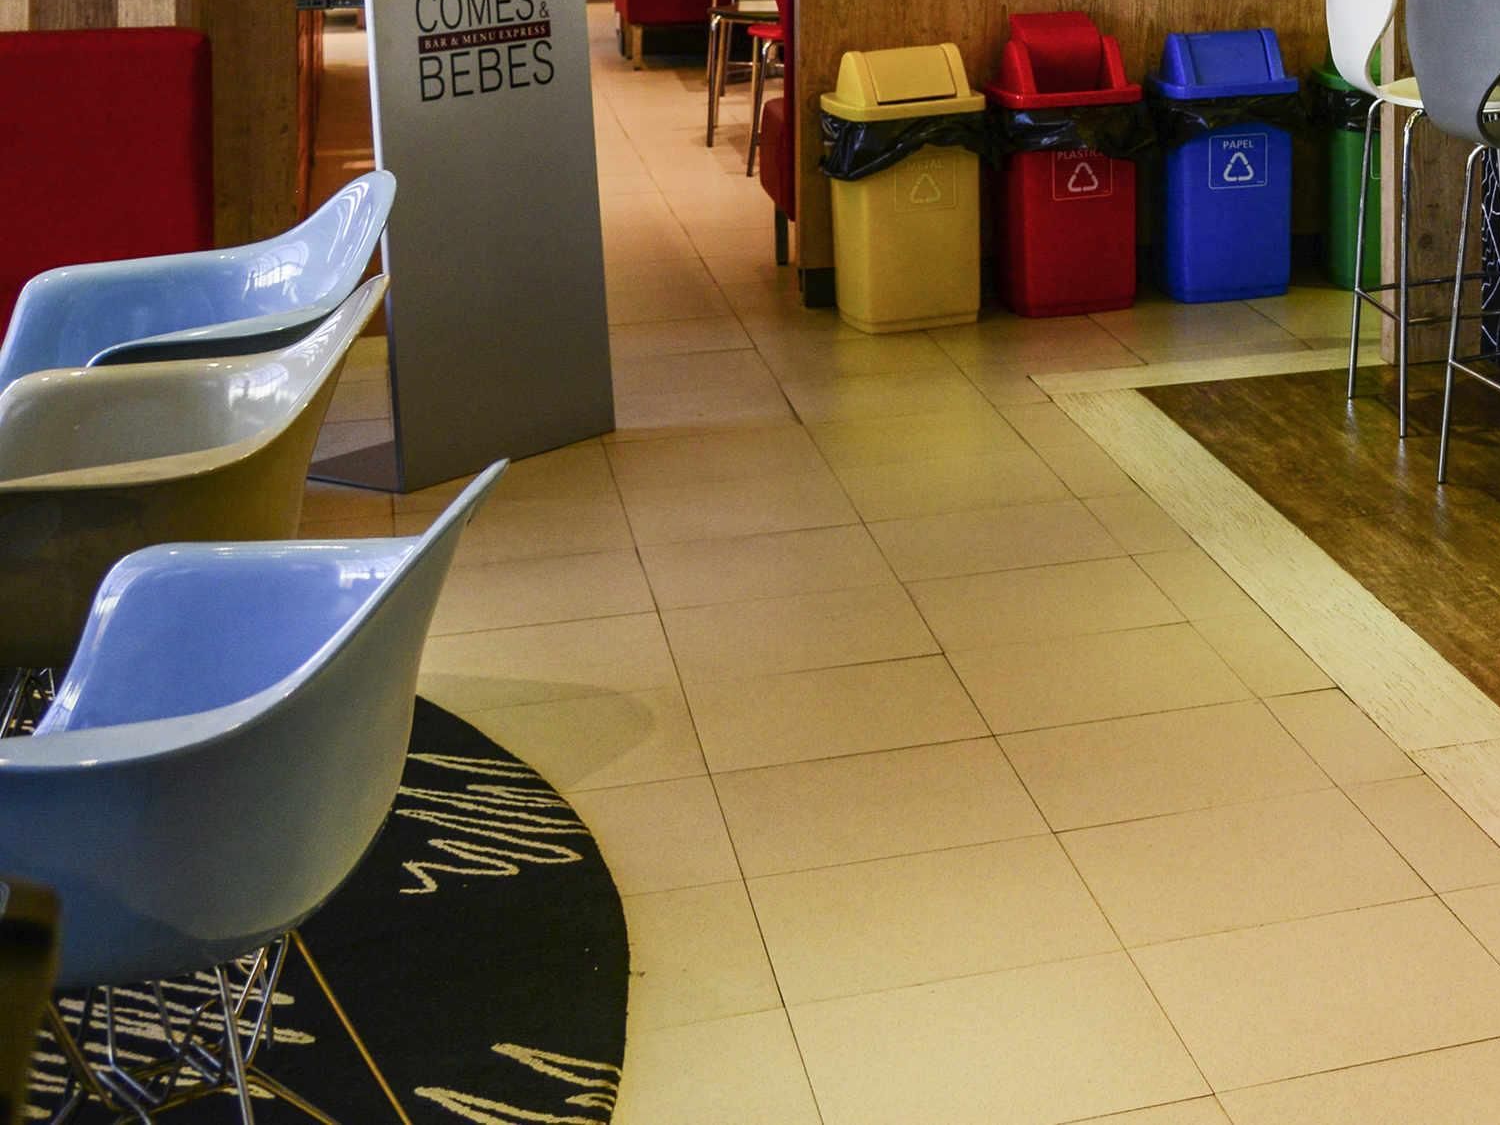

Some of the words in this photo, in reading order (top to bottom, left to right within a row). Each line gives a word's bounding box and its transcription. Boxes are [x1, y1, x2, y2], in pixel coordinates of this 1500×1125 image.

[539, 1, 550, 18] &
[425, 39, 447, 49] BAR
[463, 32, 496, 44] MENU
[500, 25, 546, 40] EXPRESS
[420, 40, 554, 102] BEBES
[1223, 139, 1254, 149] PAPEL
